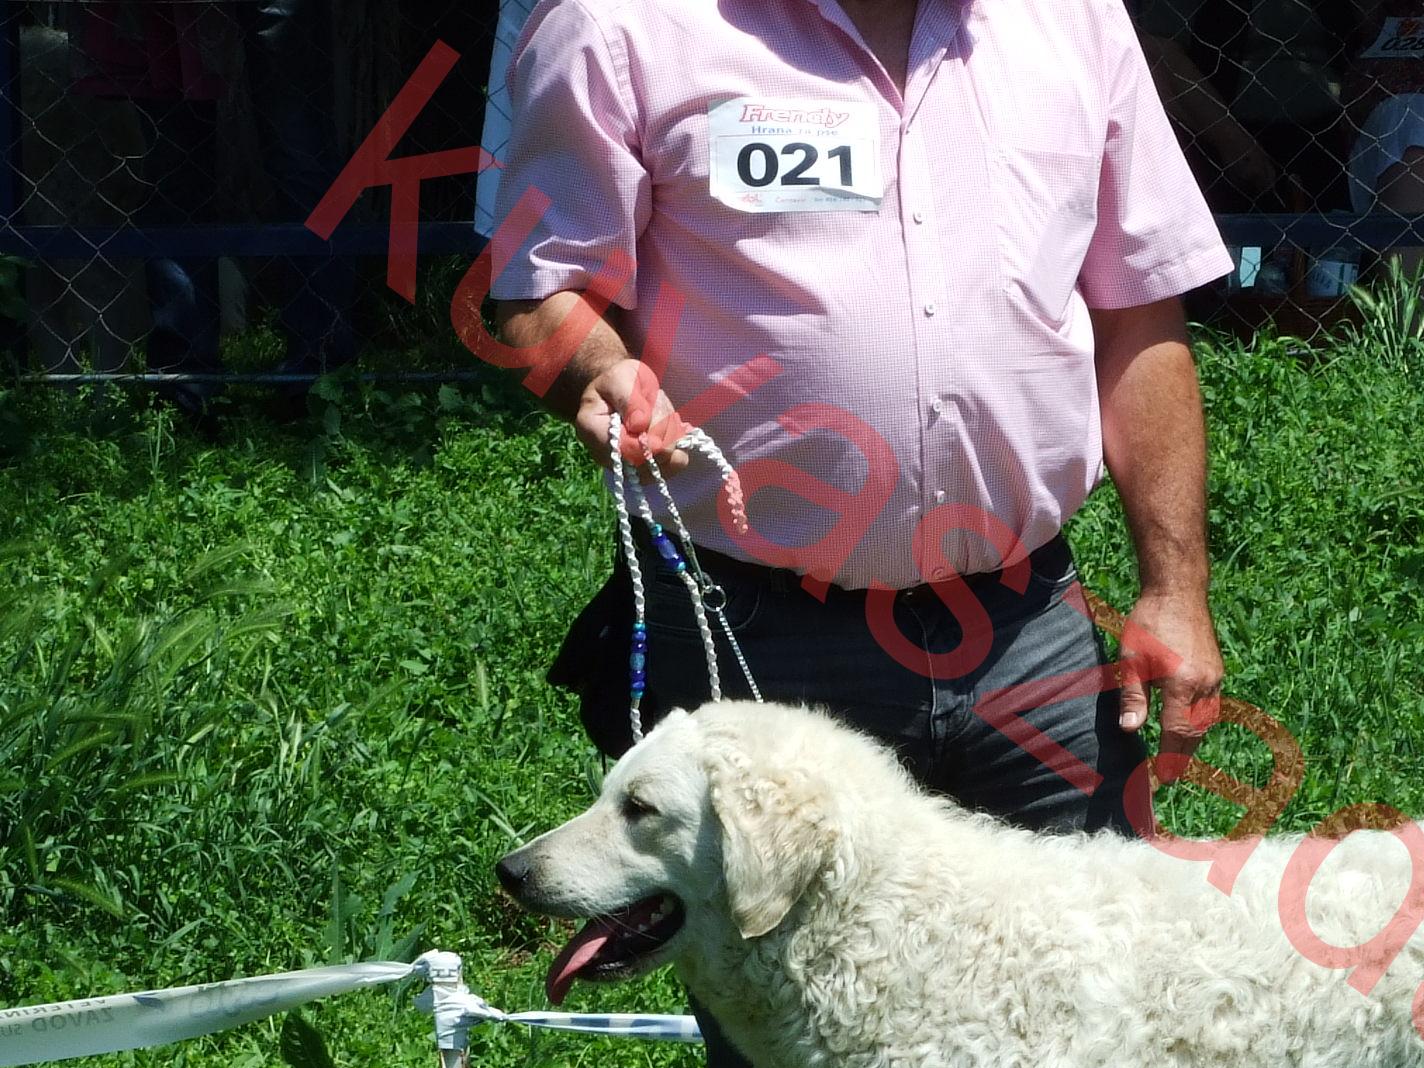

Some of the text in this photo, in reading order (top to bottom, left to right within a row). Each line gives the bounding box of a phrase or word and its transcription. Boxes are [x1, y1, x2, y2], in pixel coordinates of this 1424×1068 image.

[740, 103, 850, 128] Frendy
[751, 125, 793, 135] Hrana
[737, 142, 853, 187] 021
